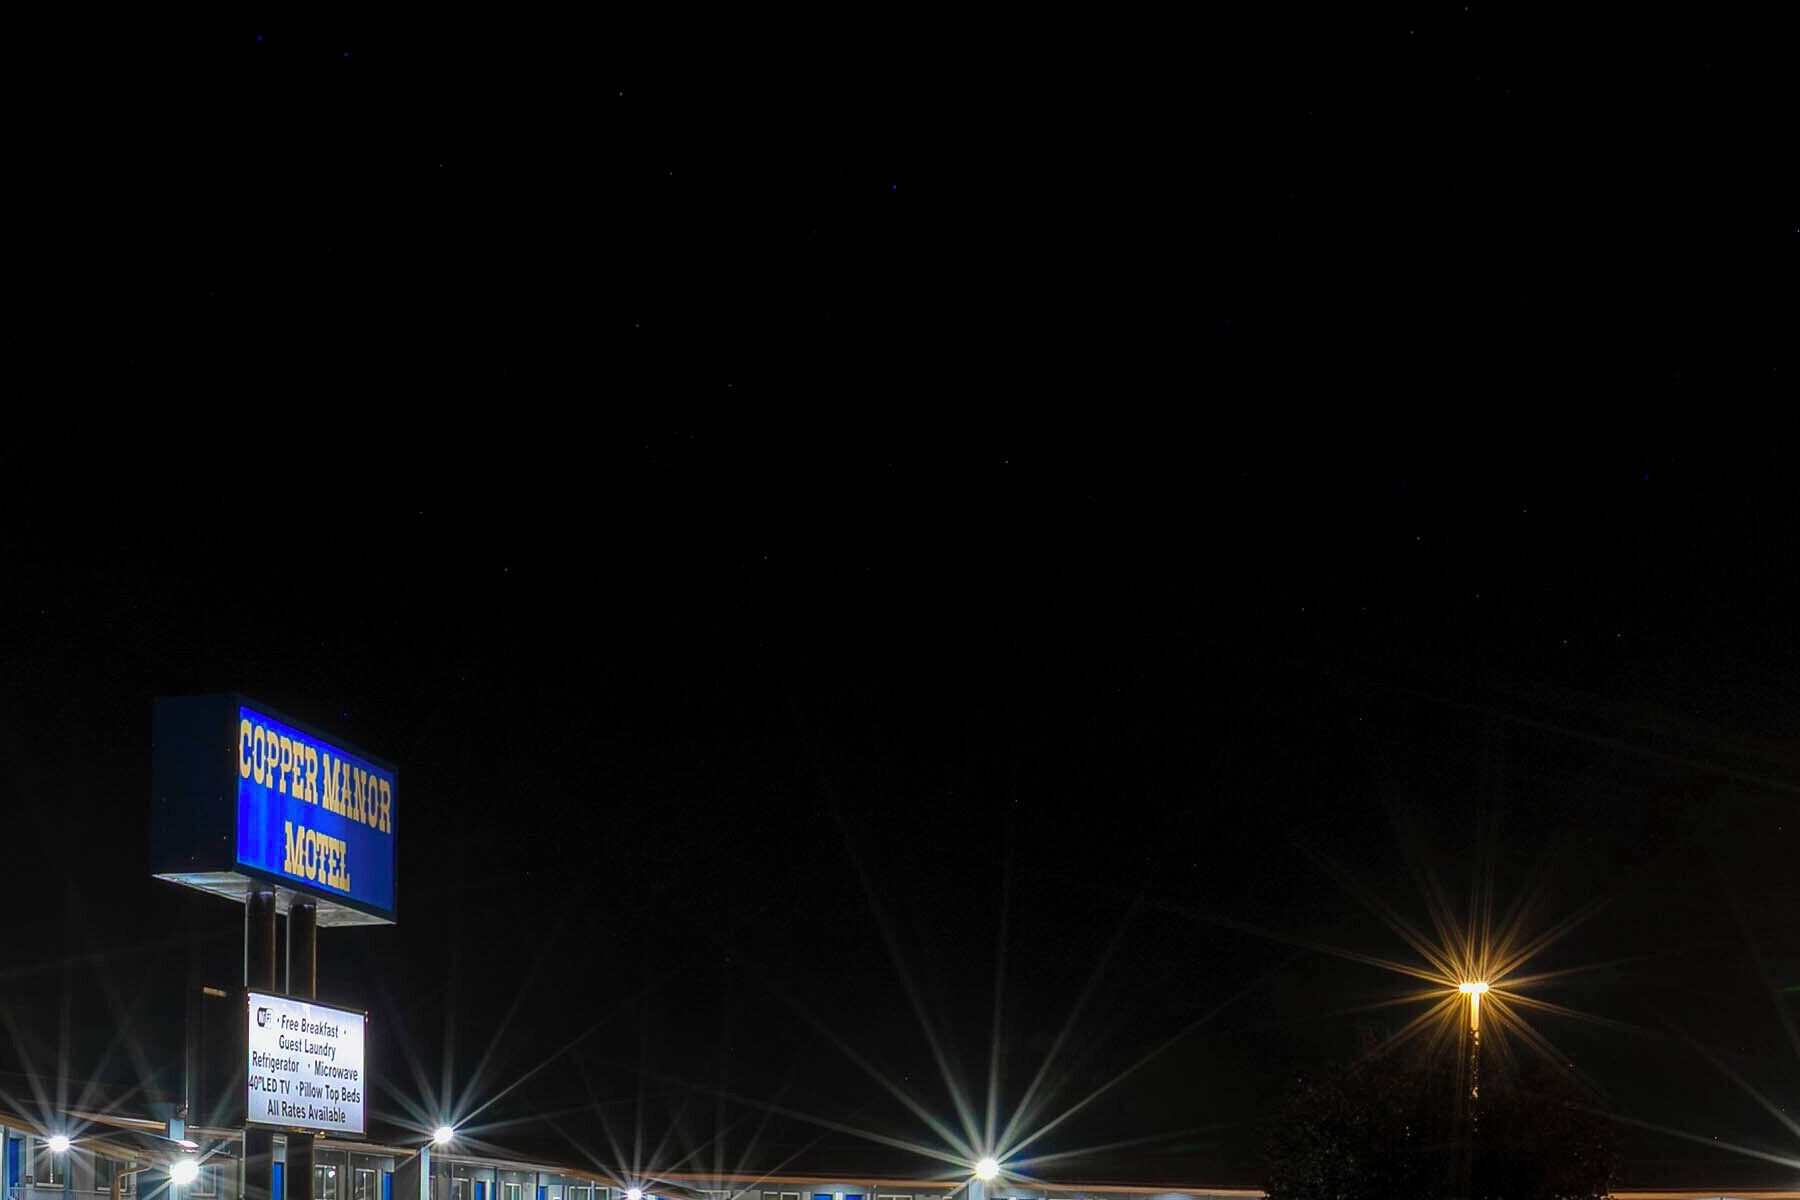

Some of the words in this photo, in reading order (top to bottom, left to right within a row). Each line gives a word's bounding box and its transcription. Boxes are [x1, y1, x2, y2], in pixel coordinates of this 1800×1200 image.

[239, 719, 318, 805] COPPER
[322, 753, 391, 834] MANOR
[284, 821, 350, 892] MOTEL
[281, 1015, 299, 1031] Free
[301, 1018, 338, 1038] Breakfast
[279, 1035, 302, 1052] Guest
[305, 1039, 336, 1061] Laundry
[252, 1051, 299, 1073] Refrigerator
[314, 1060, 358, 1081] Microwave
[280, 1080, 290, 1095] TV
[299, 1081, 323, 1098] Pillow
[325, 1085, 339, 1104] Top
[341, 1087, 360, 1103] Beds
[267, 1099, 279, 1116] All
[281, 1101, 306, 1119] Rates
[308, 1104, 346, 1123] Available
